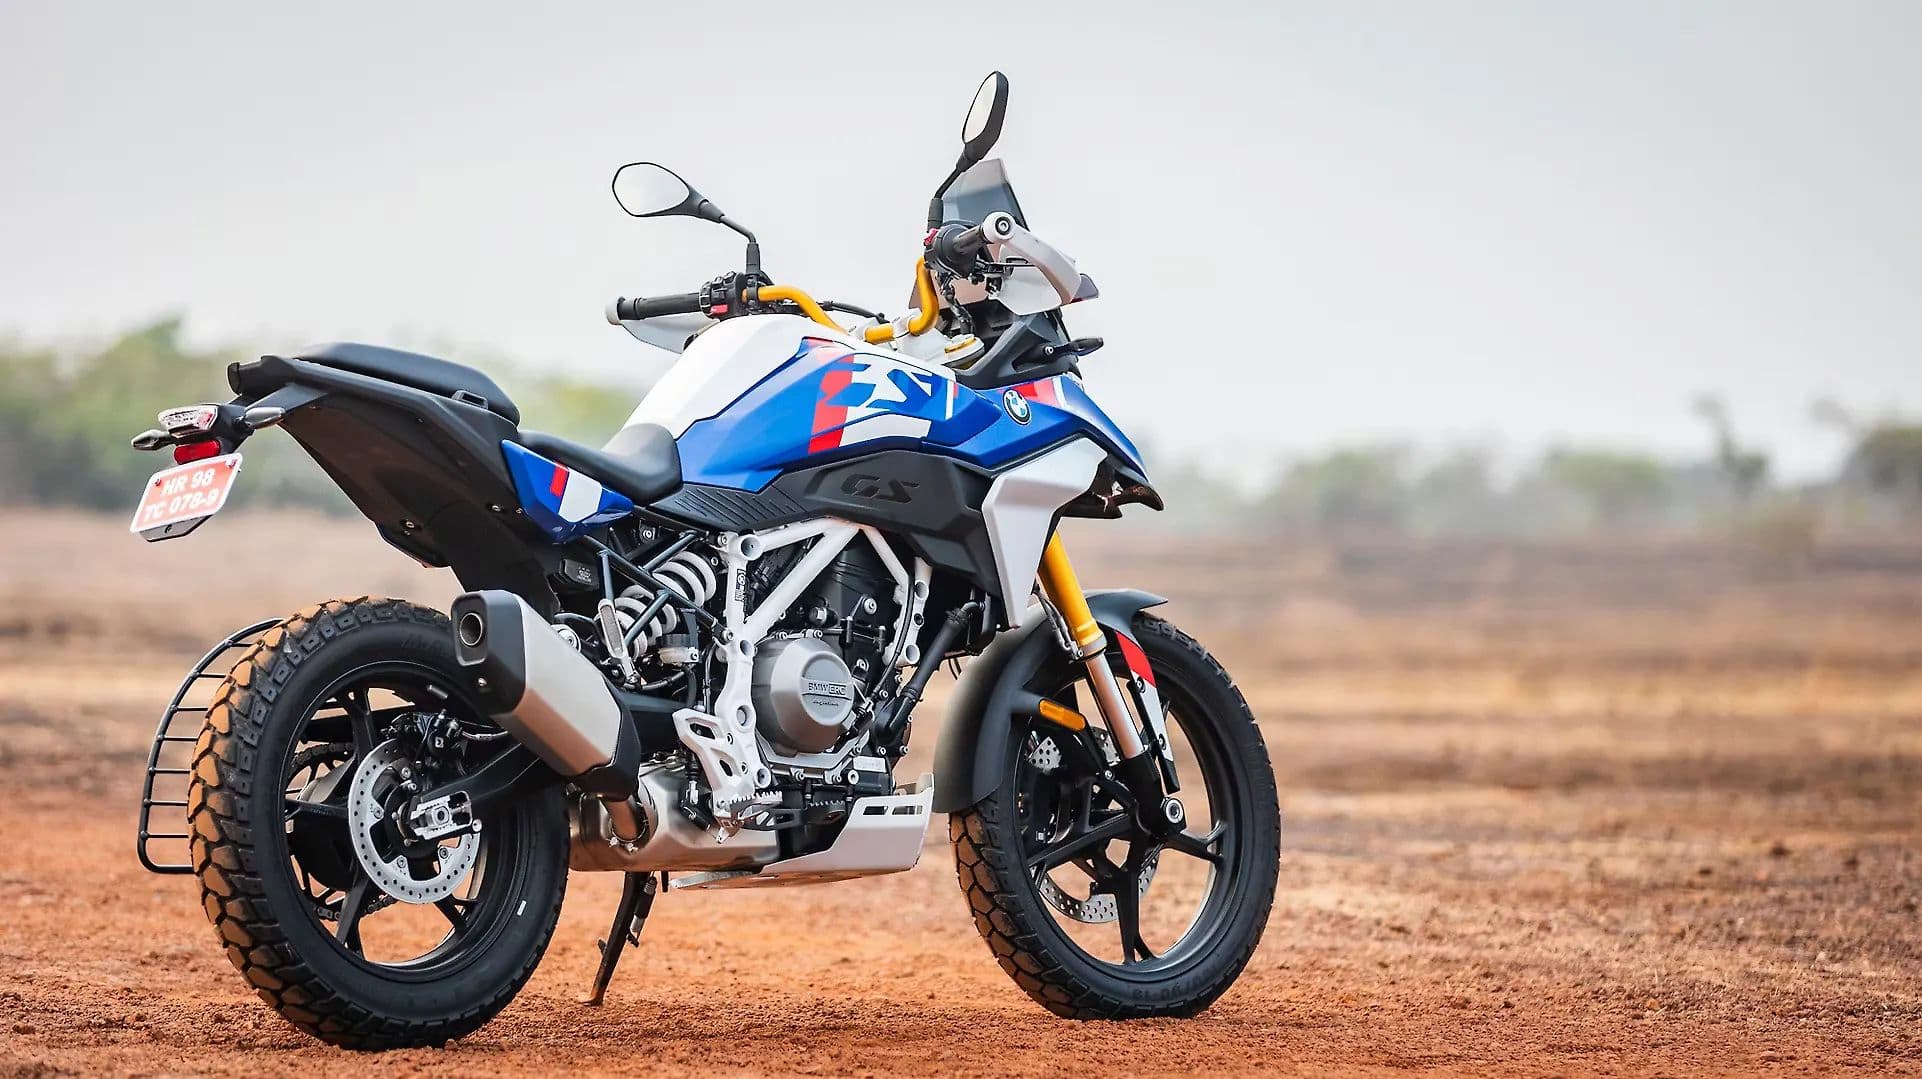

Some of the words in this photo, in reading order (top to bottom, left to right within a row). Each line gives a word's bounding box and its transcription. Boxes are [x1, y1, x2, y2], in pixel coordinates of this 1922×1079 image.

[161, 473, 188, 497] HR
[191, 467, 215, 488] 98
[840, 473, 921, 504] GS
[145, 501, 168, 521] TC
